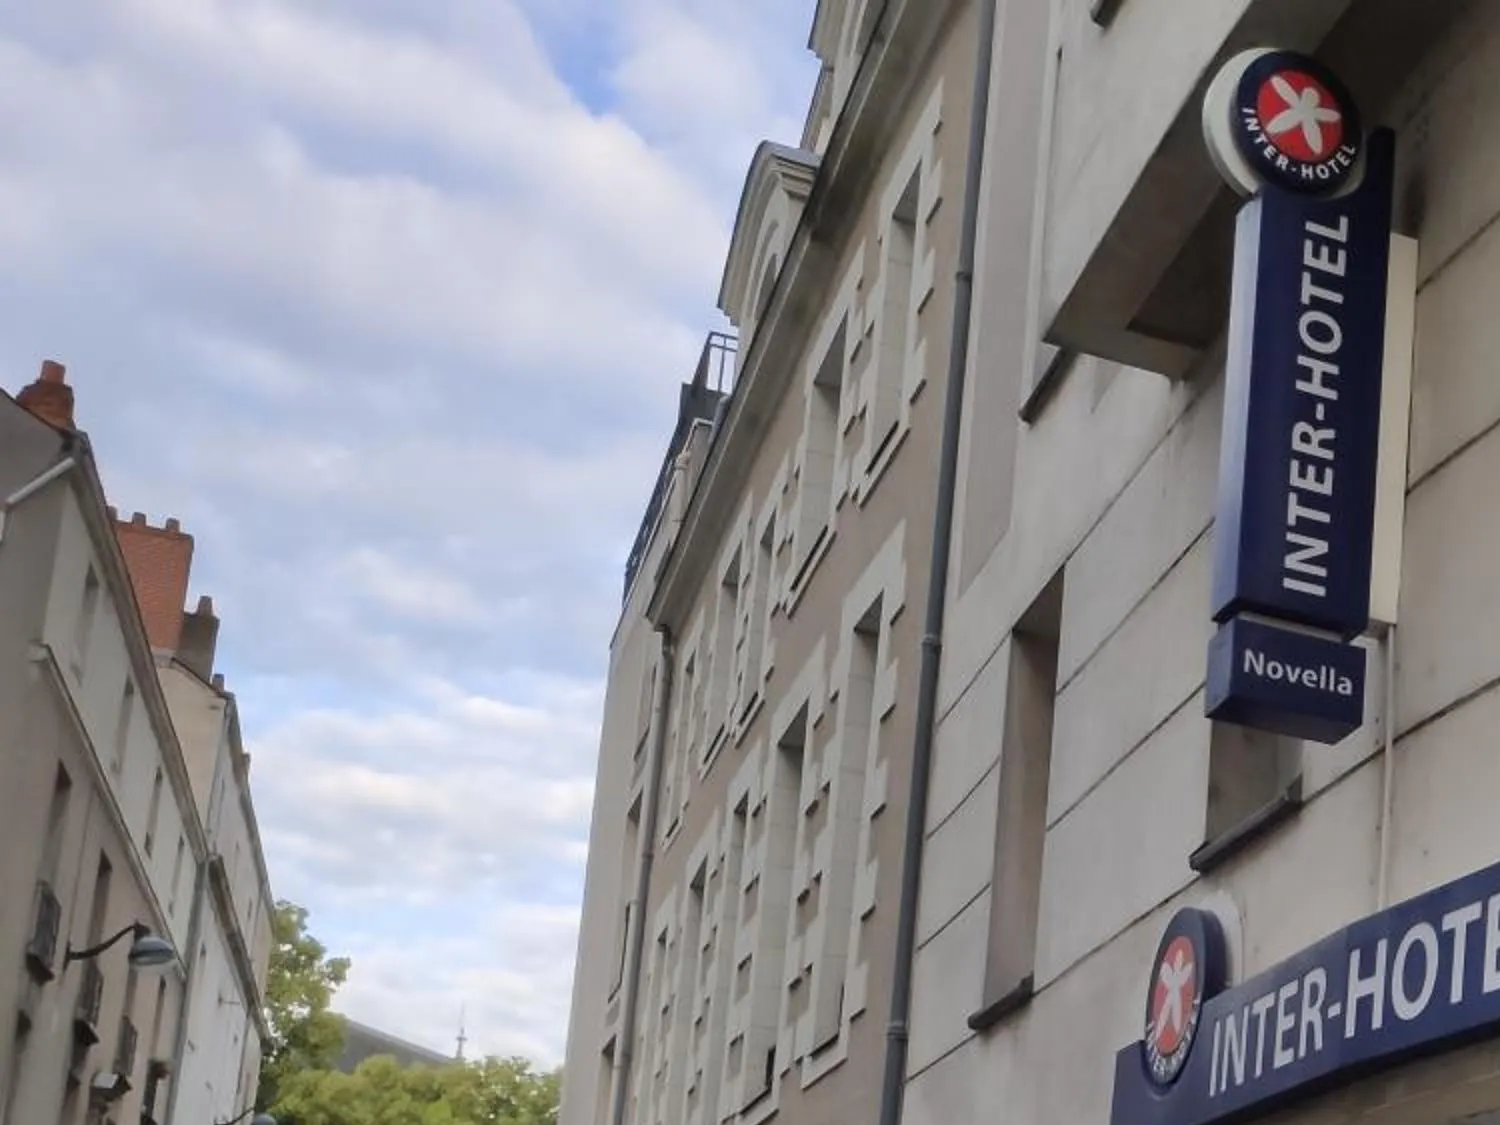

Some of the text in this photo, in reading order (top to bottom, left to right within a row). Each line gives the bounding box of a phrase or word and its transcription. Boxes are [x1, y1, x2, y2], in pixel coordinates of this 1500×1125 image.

[1242, 106, 1356, 180] INTER-HOTEL
[1283, 214, 1348, 597] INTER-HOTEL
[1243, 648, 1353, 695] Novella
